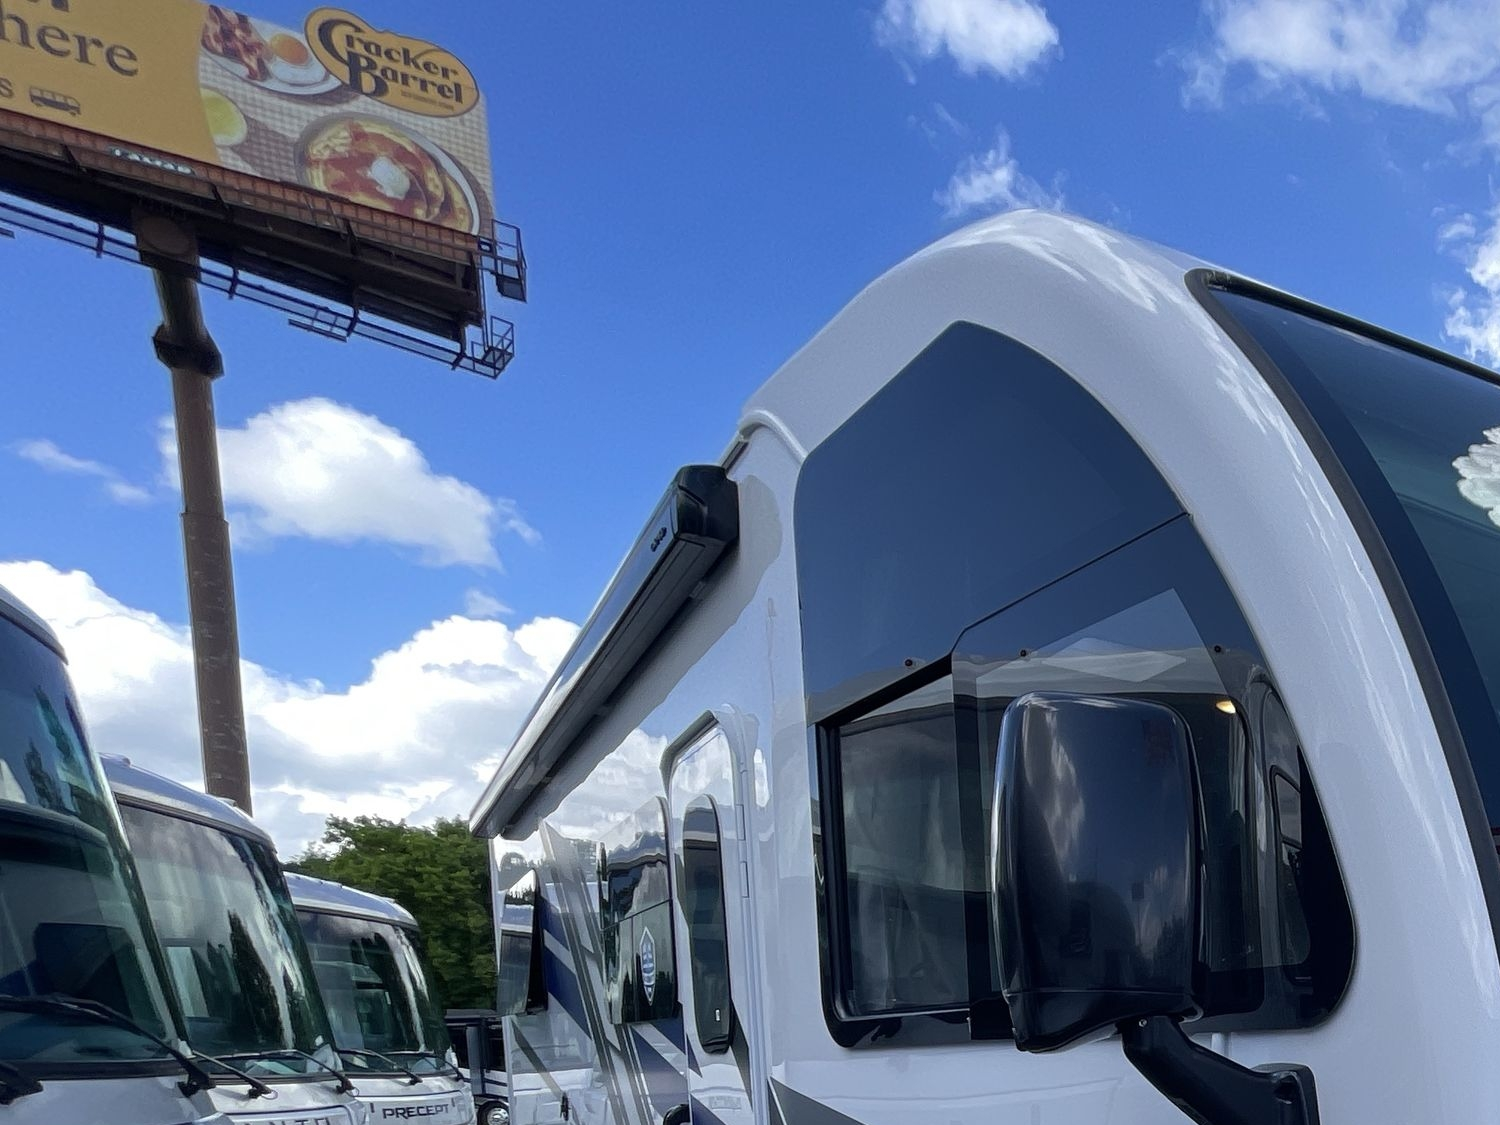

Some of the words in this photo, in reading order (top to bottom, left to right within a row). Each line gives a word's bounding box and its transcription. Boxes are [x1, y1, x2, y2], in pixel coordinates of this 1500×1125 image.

[0, 0, 138, 77] here
[318, 19, 459, 80] Cracker
[348, 51, 464, 104] Barrel
[382, 1103, 450, 1120] PRECEPT
